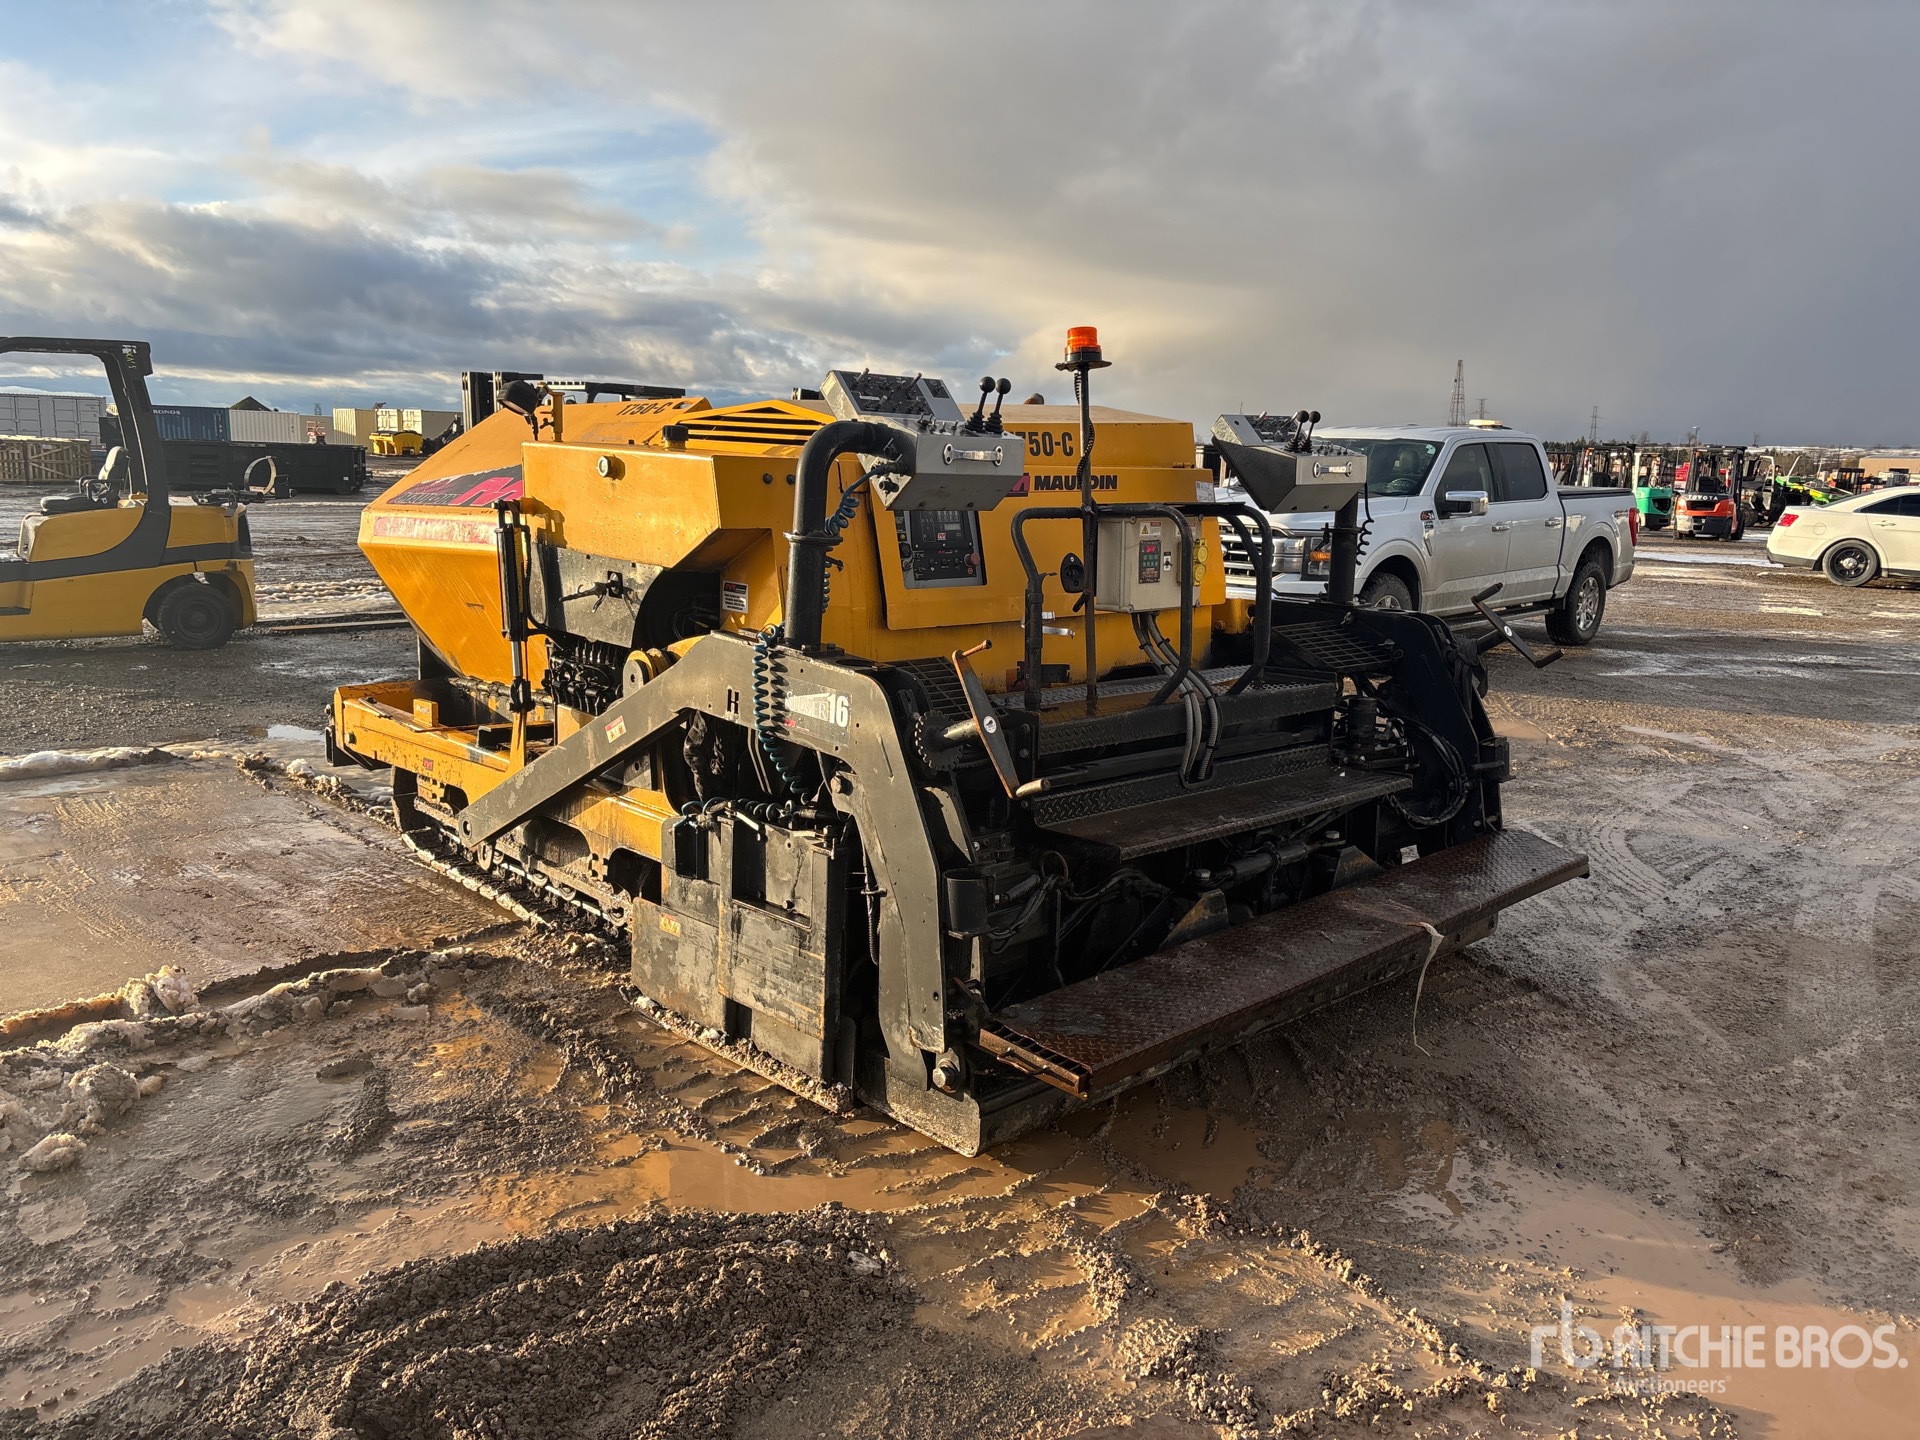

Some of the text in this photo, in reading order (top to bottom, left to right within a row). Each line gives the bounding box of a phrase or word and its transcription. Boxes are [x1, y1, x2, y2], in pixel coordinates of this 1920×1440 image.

[617, 402, 673, 416] 1750-C
[1010, 431, 1074, 457] 50-C
[1034, 475, 1118, 491] MAUDIN
[827, 693, 849, 728] 16
